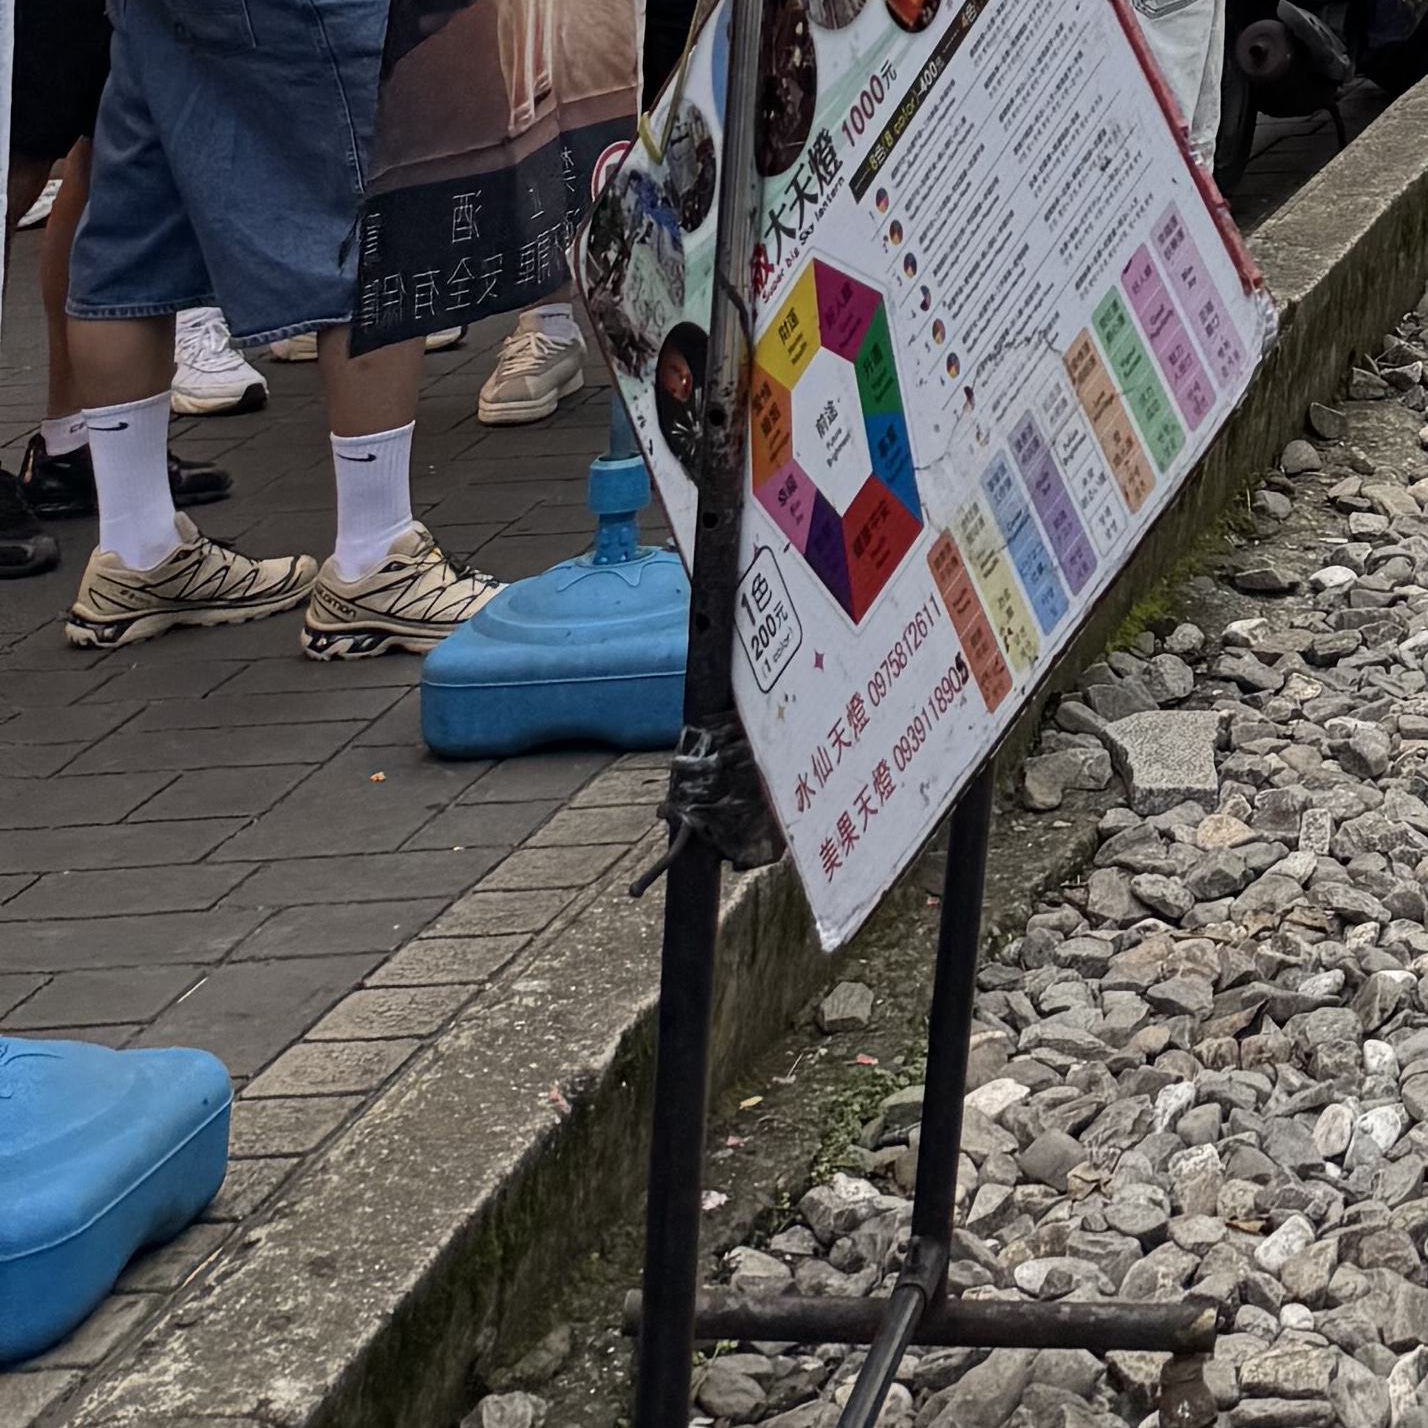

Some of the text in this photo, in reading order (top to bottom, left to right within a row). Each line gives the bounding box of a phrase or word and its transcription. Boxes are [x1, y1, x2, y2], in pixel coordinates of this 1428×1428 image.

[839, 48, 898, 155] 1000元
[798, 217, 815, 248] Sky
[777, 305, 799, 347] 財運
[814, 395, 838, 442] 前途
[739, 563, 773, 632] 1色
[749, 593, 788, 665] 200元
[790, 583, 941, 827] 水仙天燈 0975812611
[817, 746, 897, 892] 美果天燈
[891, 643, 970, 784] 0939118905
